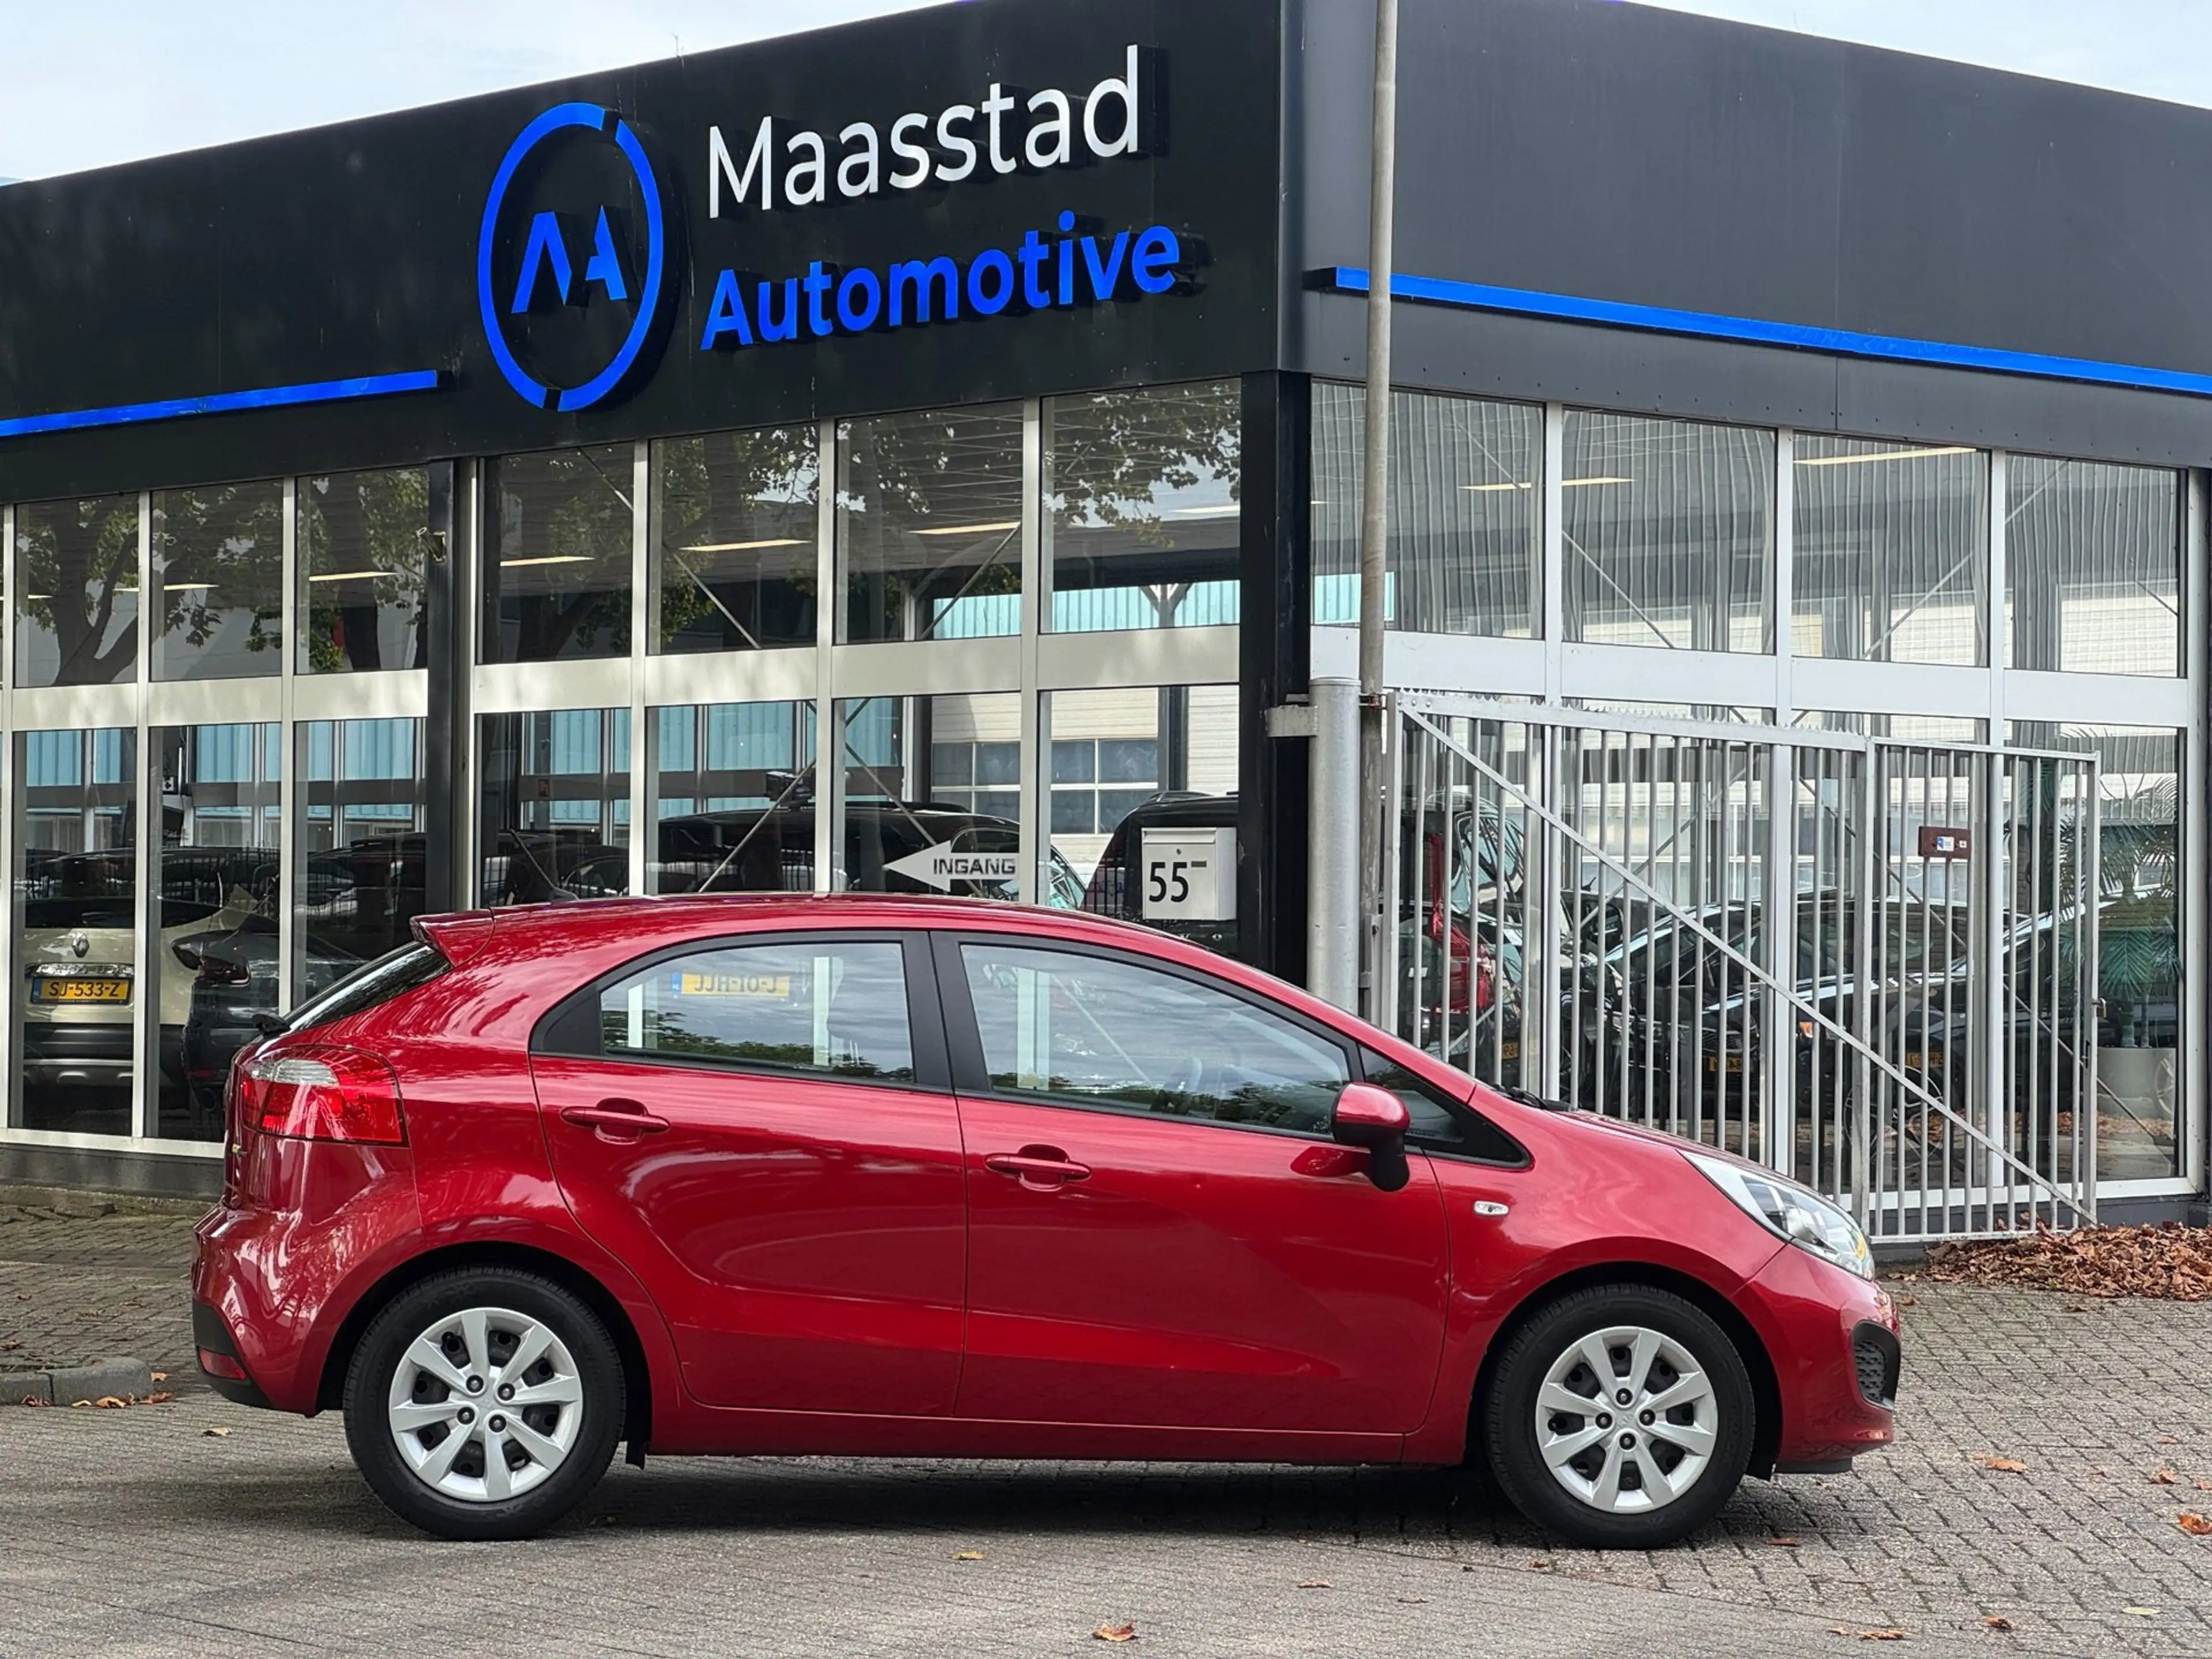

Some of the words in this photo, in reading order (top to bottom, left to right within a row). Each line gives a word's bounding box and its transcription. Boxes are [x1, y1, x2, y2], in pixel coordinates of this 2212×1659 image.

[710, 45, 1138, 218] Maasstad
[700, 210, 1180, 350] Automotive
[933, 858, 1016, 875] INGANG
[48, 982, 120, 998] SJ-533-Z
